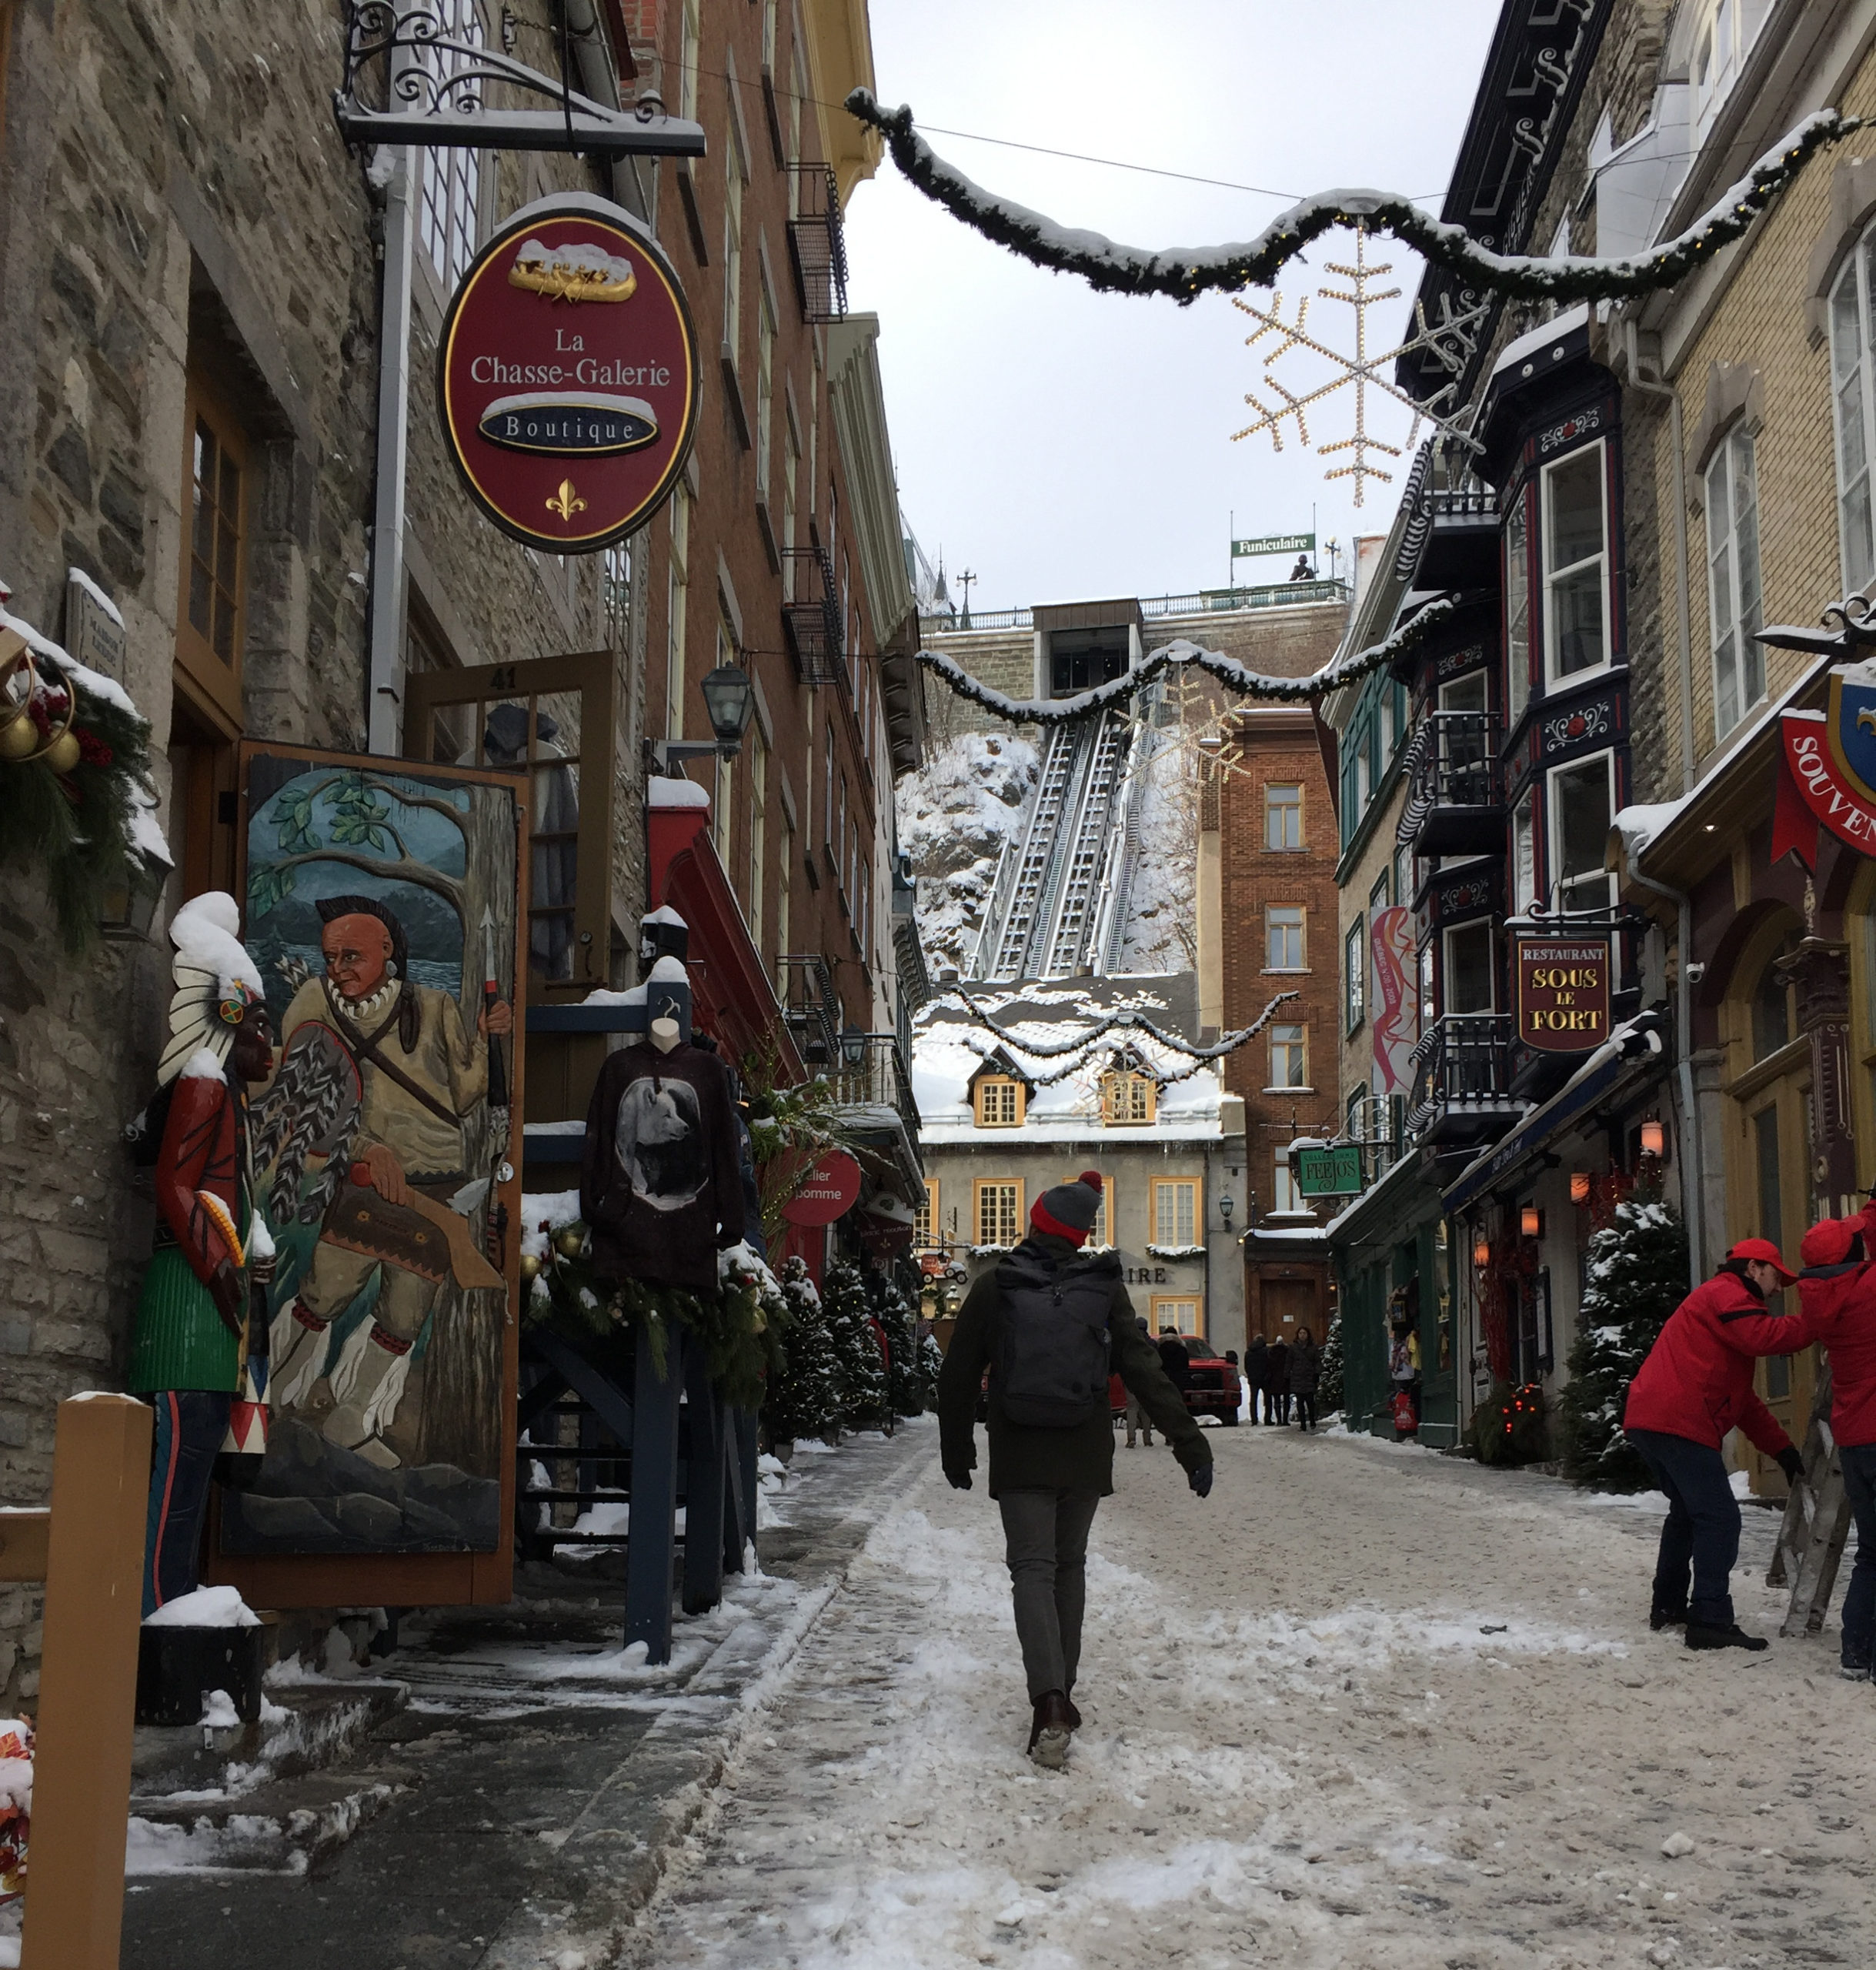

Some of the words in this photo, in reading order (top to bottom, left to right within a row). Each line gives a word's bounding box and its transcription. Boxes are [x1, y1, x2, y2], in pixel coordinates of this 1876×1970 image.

[555, 329, 584, 352] La
[470, 356, 670, 386] Chasse-Galerie
[505, 416, 633, 443] Boutique
[1239, 537, 1307, 553] Funiculaire
[490, 666, 516, 690] 41
[1522, 948, 1604, 960] RESTAURANT
[1532, 968, 1597, 989] SOUS
[1554, 991, 1574, 1005] LE
[1530, 1010, 1602, 1031] FORT
[795, 1189, 842, 1200] pomme
[1121, 1267, 1166, 1283] IRE
